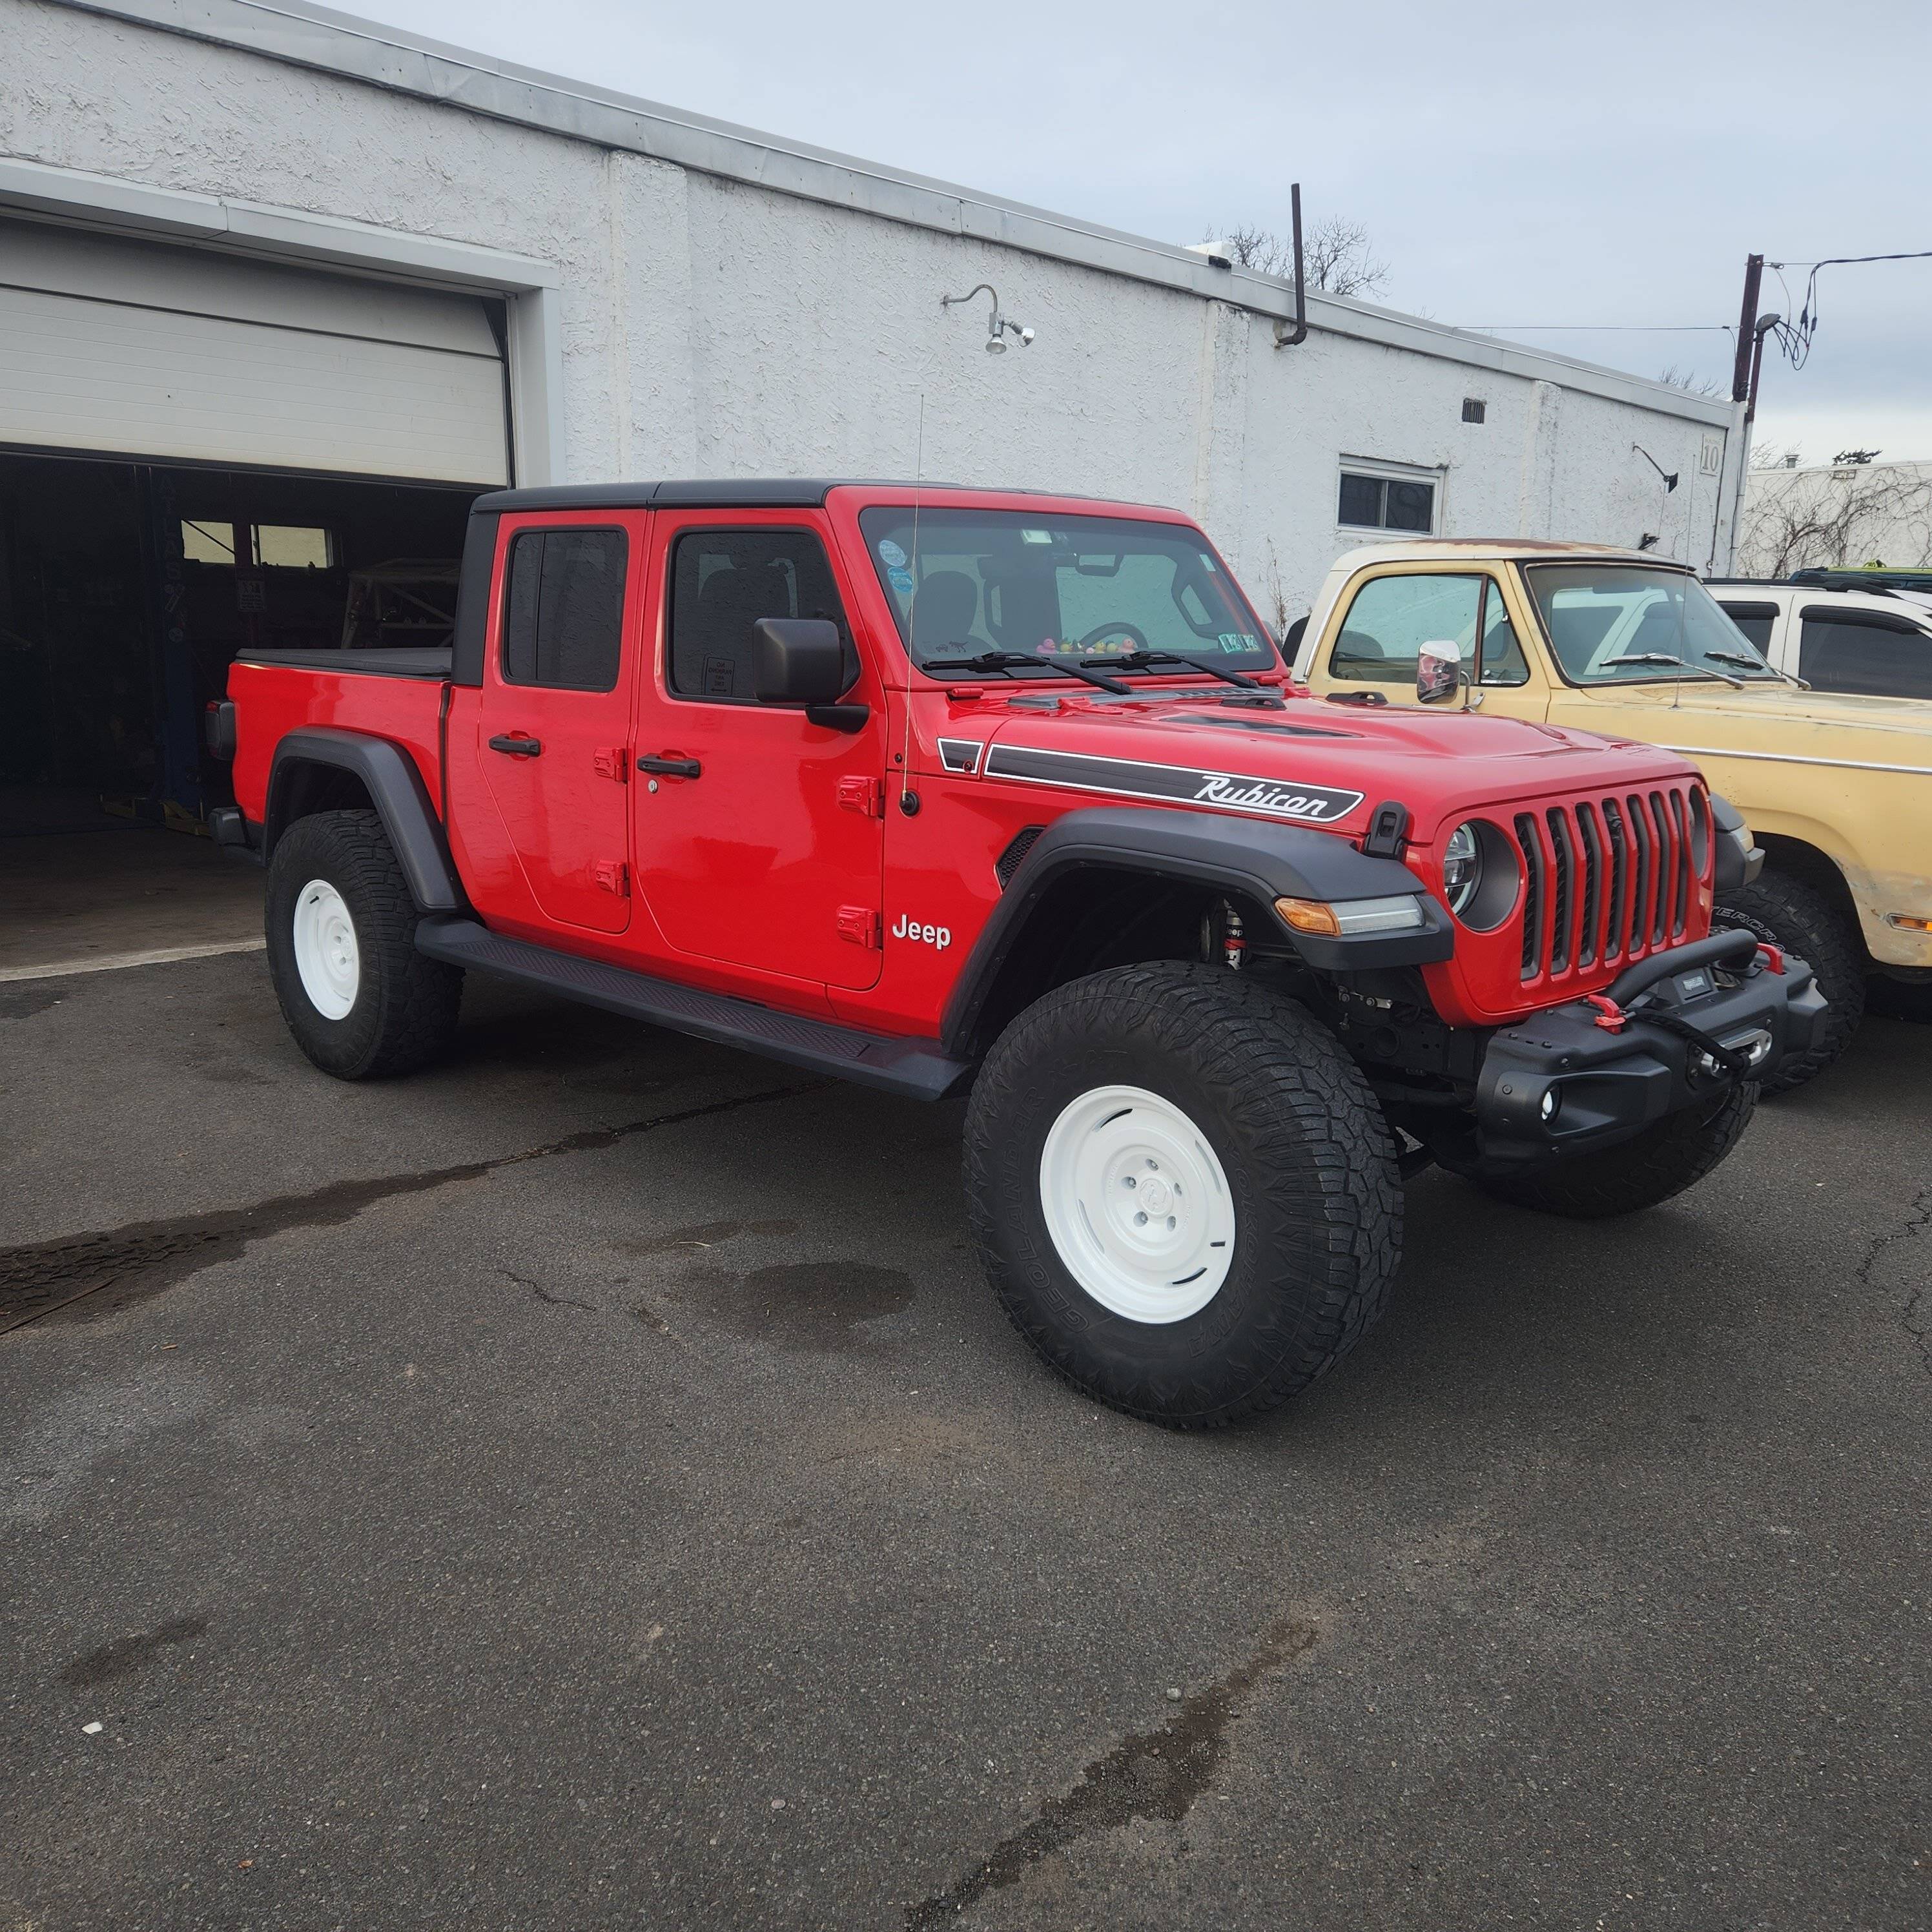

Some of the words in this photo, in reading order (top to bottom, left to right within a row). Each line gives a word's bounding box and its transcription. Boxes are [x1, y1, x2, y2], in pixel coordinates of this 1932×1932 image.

[1702, 446, 1719, 471] 10
[1193, 776, 1328, 816] Rubicon
[892, 913, 951, 951] Jeep
[1003, 1087, 1089, 1332] GEOLANDAR
[1188, 1136, 1259, 1357] YOKOHAMA
